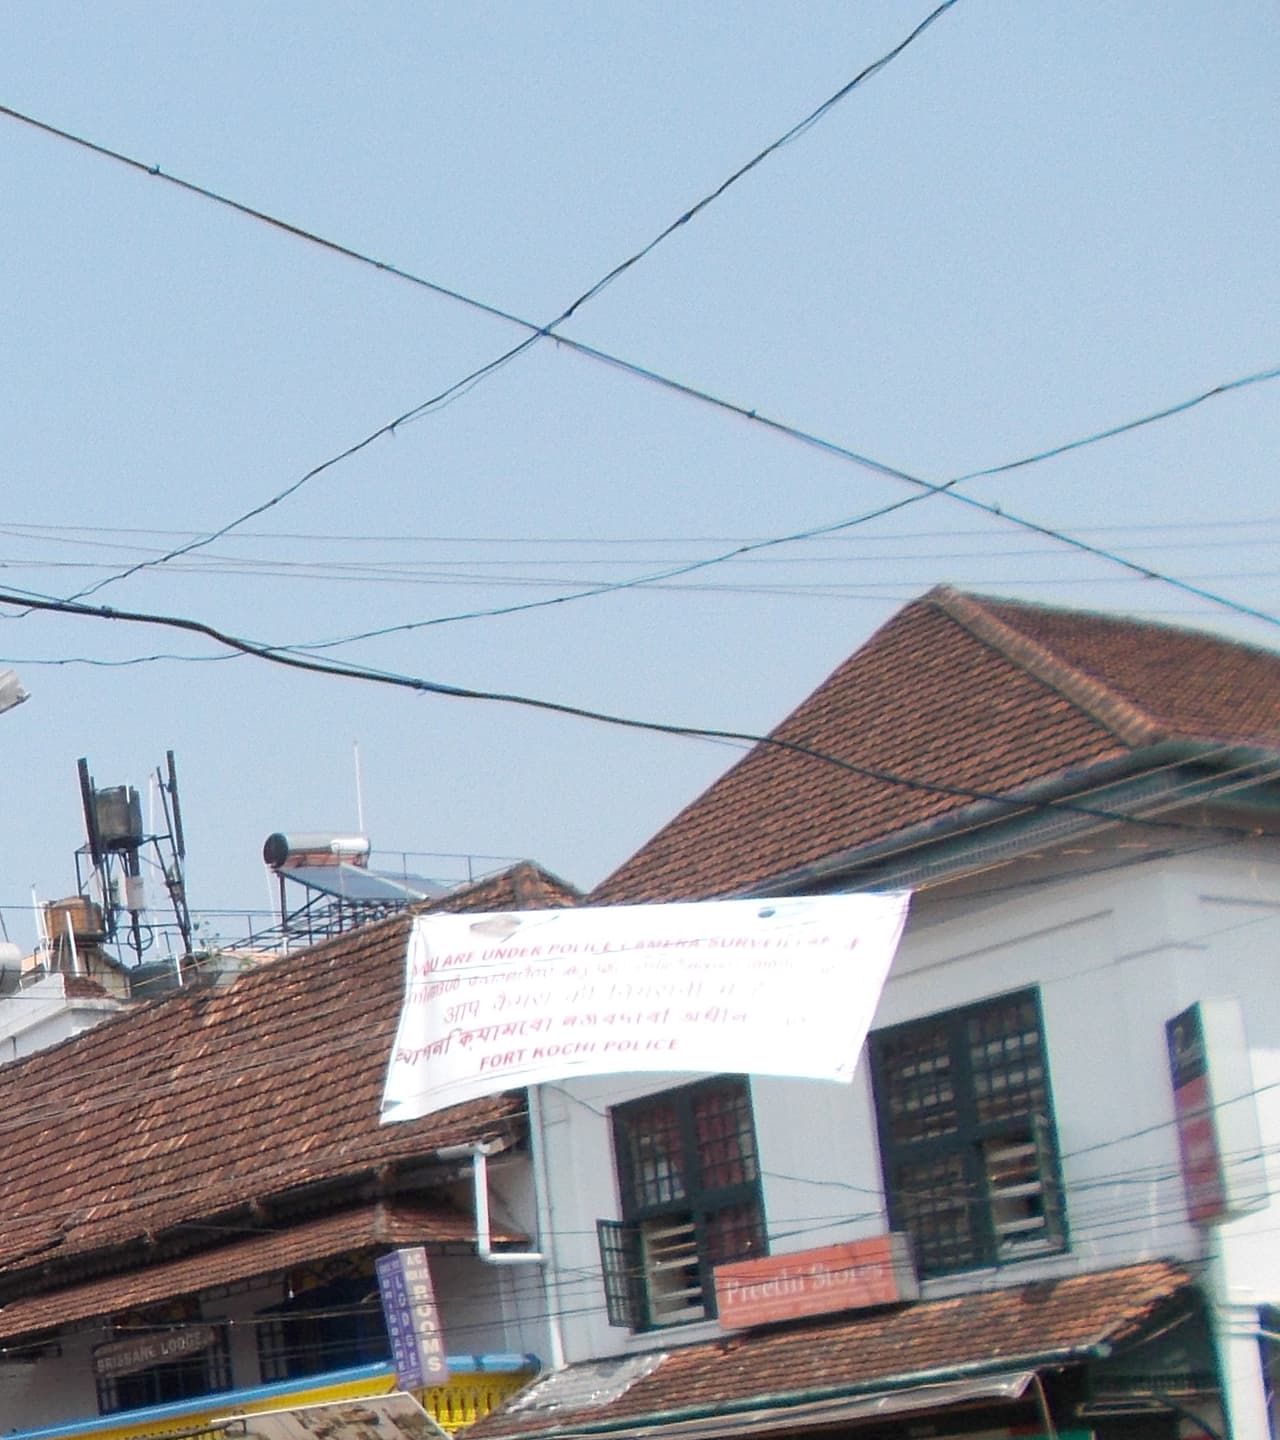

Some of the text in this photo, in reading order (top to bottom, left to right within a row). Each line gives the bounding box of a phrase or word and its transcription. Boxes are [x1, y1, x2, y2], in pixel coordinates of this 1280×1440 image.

[442, 951, 473, 968] ARE
[481, 944, 541, 961] UNDER
[479, 1037, 681, 1072] FORT KOCHI POLICE
